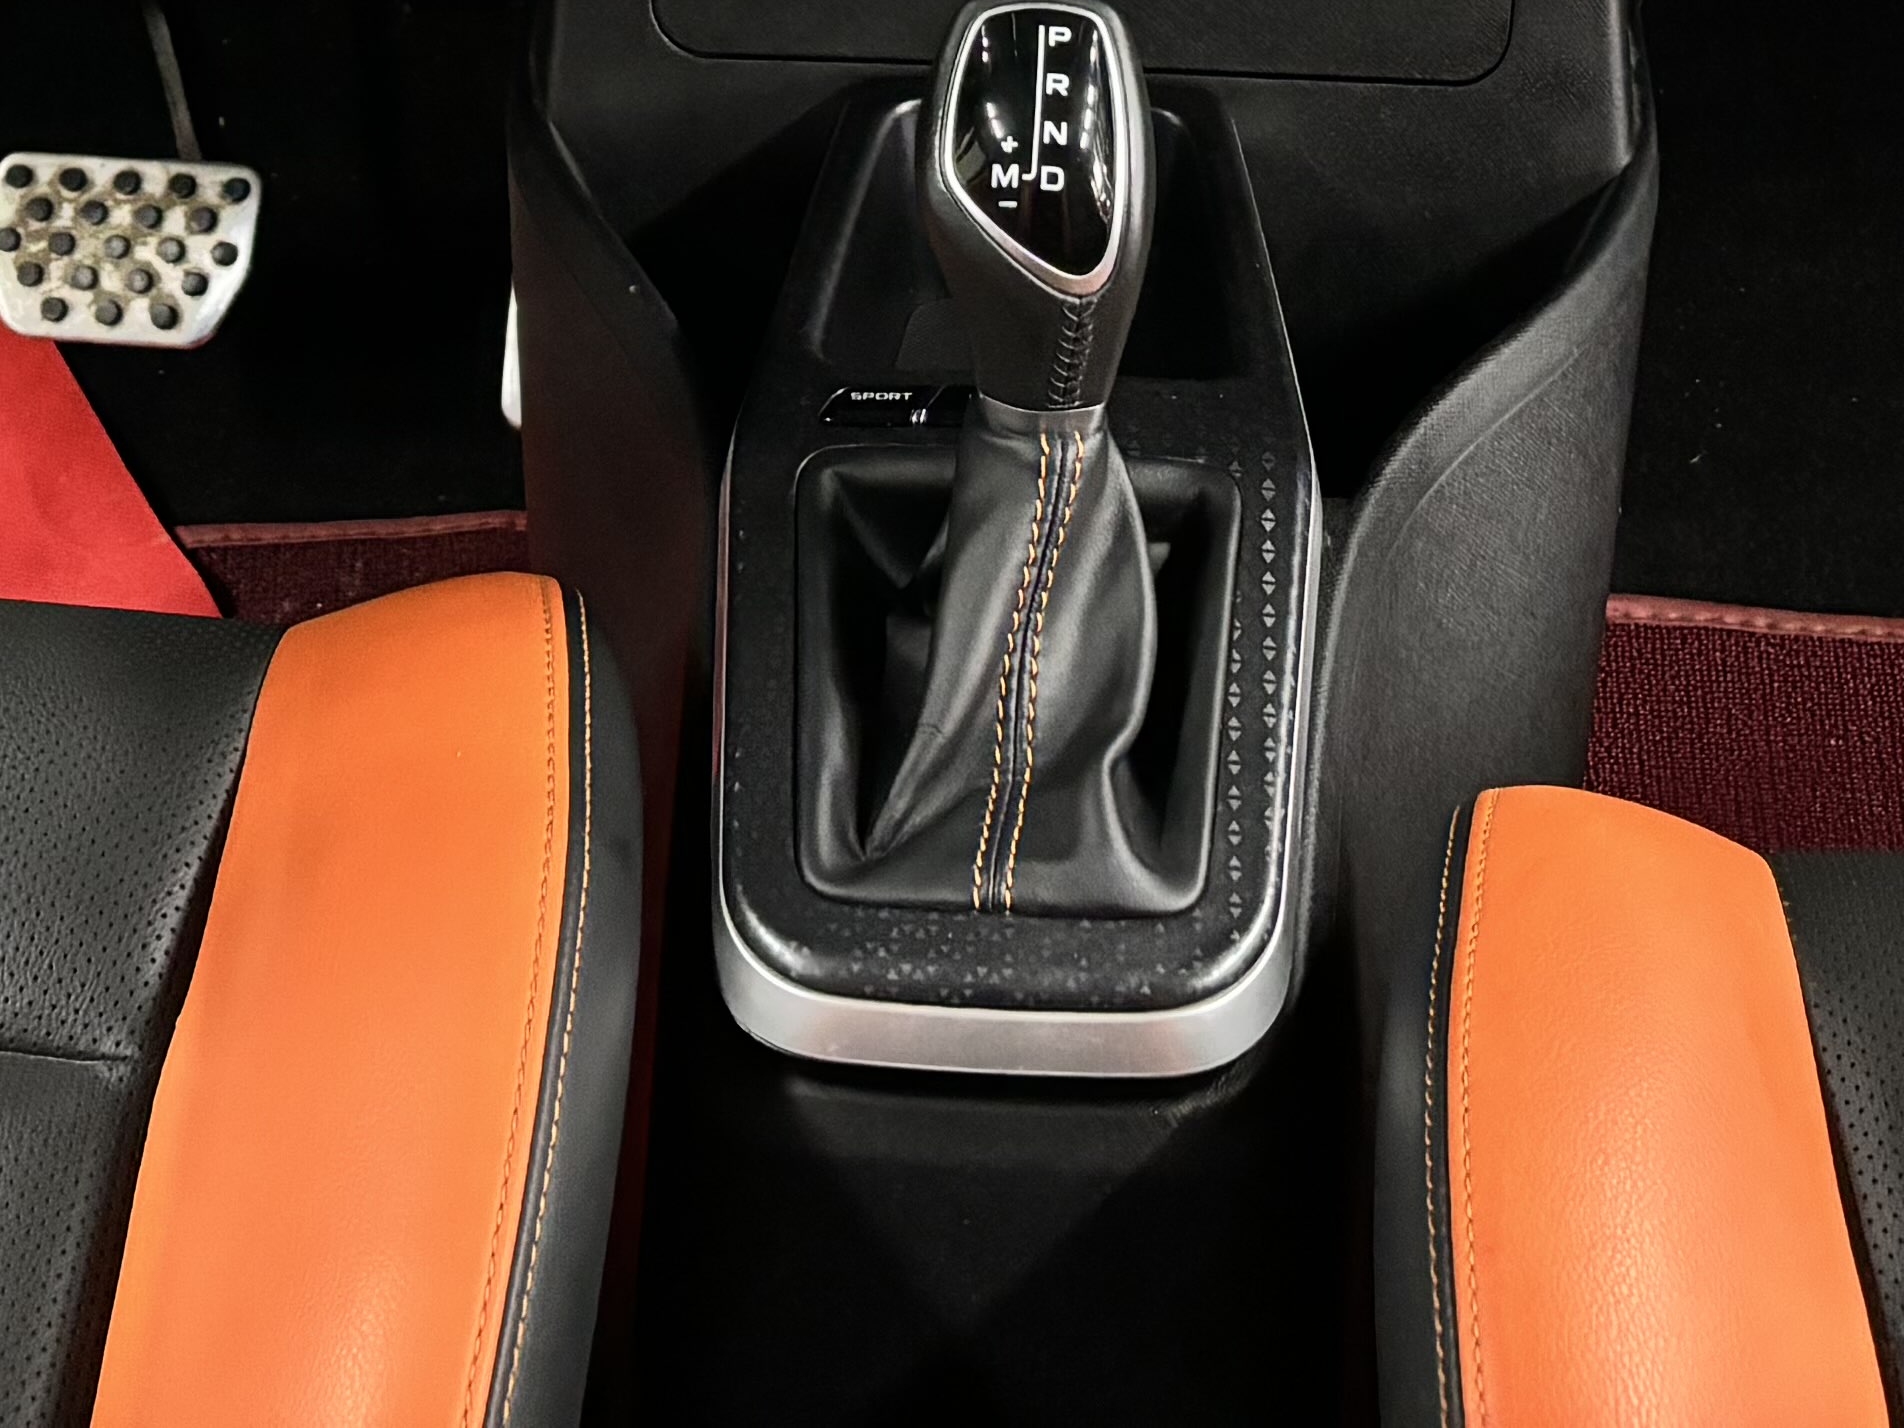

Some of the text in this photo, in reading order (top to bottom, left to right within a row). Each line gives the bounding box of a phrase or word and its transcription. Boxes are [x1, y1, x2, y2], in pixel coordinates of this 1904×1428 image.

[1048, 25, 1072, 47] P
[1045, 72, 1070, 97] R
[1042, 120, 1068, 146] N
[990, 163, 1020, 189] M
[1039, 164, 1065, 192] D
[849, 391, 913, 401] SPORT
